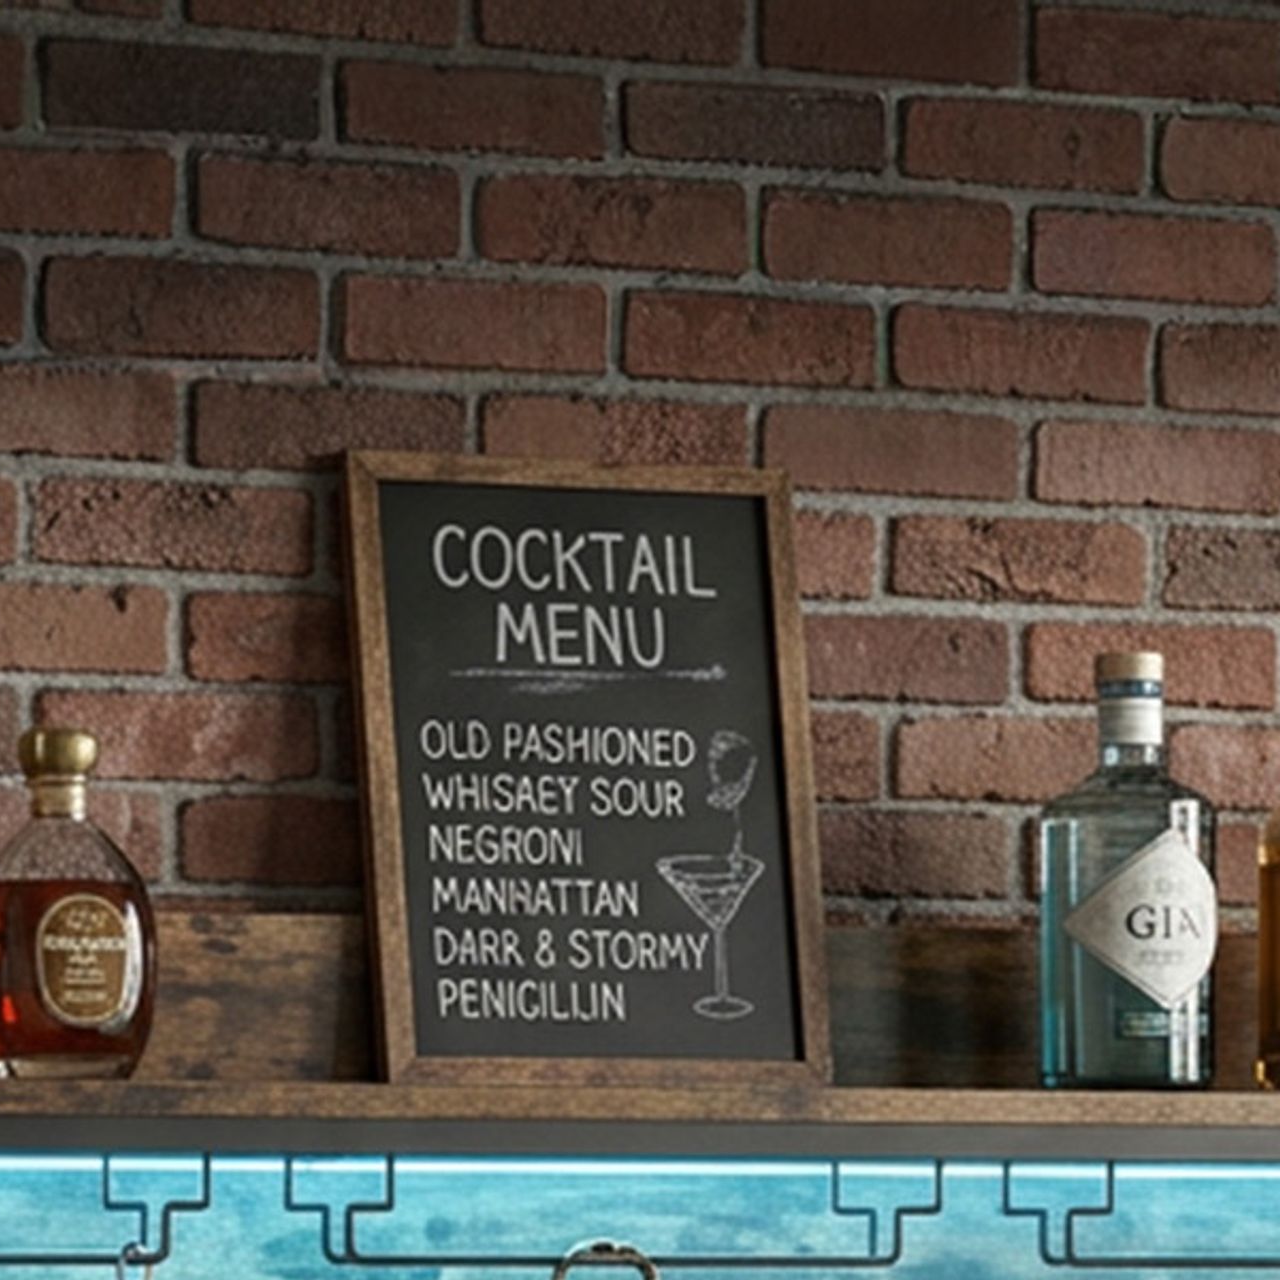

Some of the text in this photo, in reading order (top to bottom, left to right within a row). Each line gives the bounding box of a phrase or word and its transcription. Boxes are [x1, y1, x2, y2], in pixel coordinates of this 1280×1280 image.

[432, 523, 718, 599] COCKTAIL
[495, 601, 665, 669] MENU
[420, 719, 491, 760] OLD
[589, 775, 685, 818] SOUR
[429, 823, 583, 866] NEGRONI
[534, 927, 557, 969] &
[568, 928, 710, 971] STORMY
